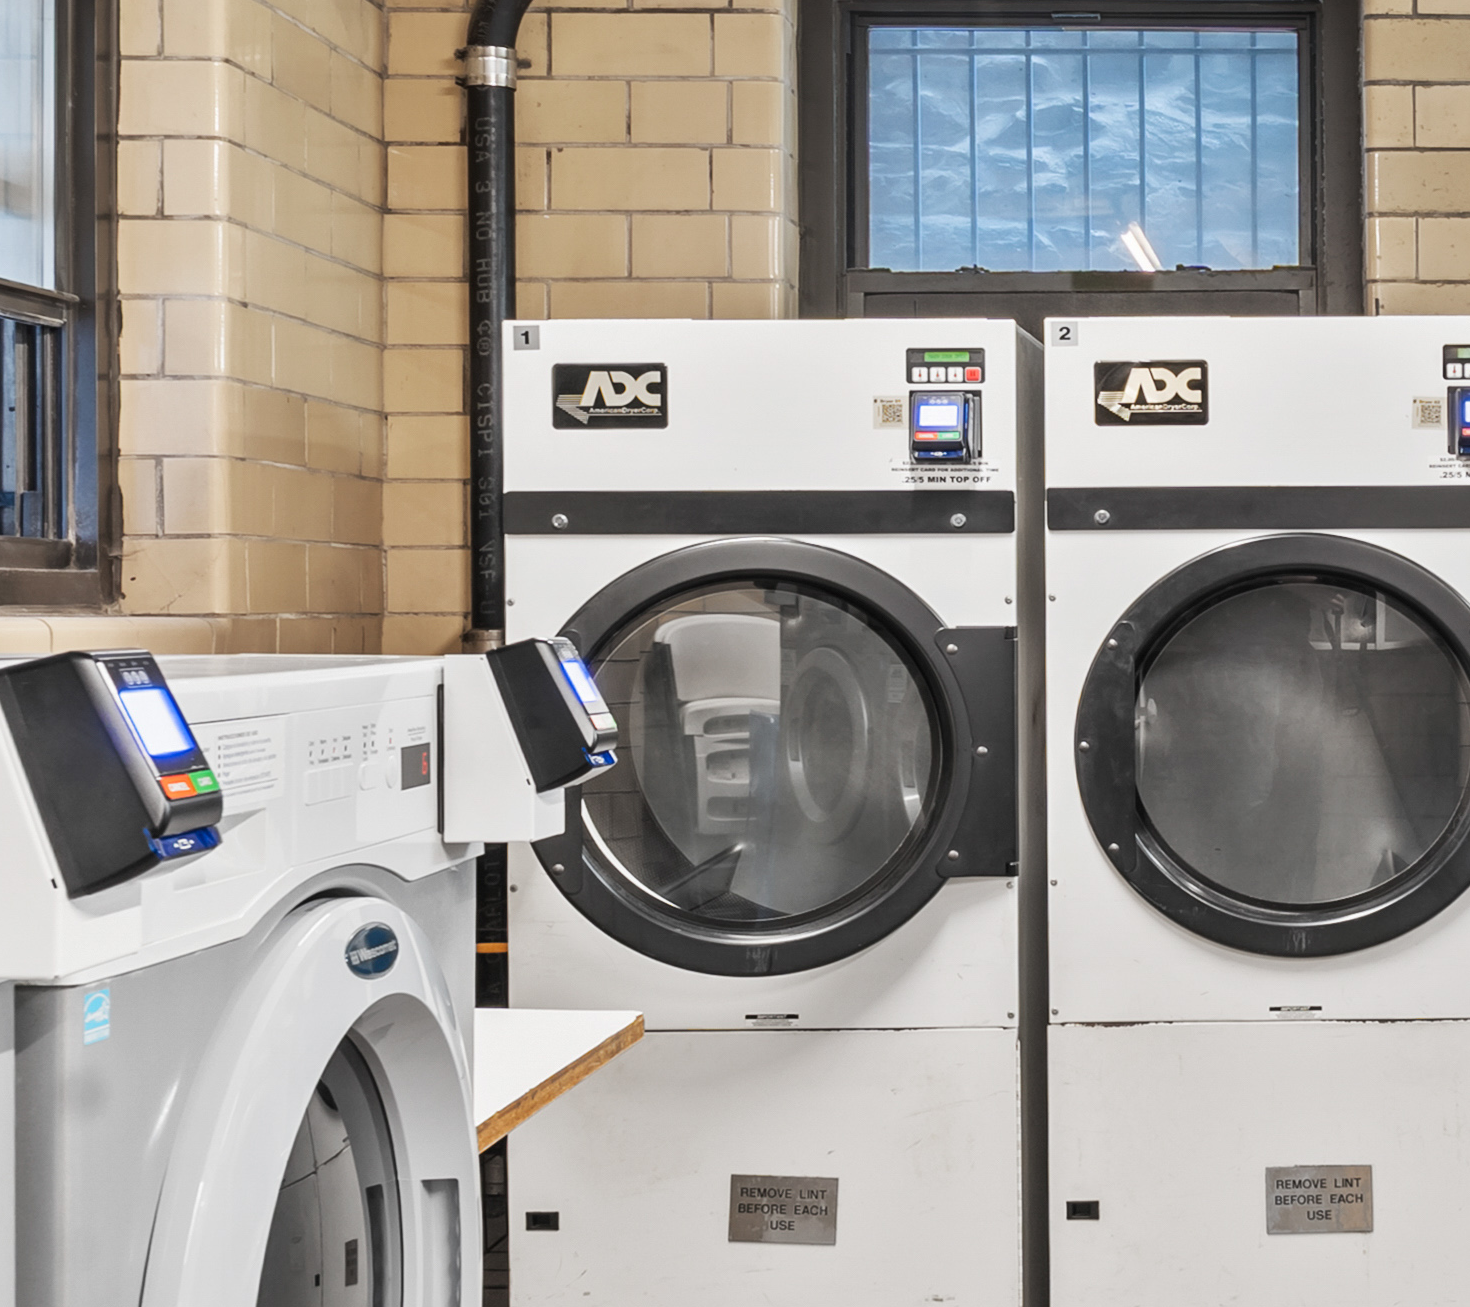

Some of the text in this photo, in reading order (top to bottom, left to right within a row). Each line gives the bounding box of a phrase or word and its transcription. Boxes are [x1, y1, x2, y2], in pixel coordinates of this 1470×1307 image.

[473, 116, 492, 164] USA
[474, 180, 491, 194] 3
[474, 211, 492, 241] NO
[474, 258, 492, 303] HUB
[520, 330, 530, 345] 1
[1058, 326, 1071, 341] 2
[579, 370, 661, 407] ADC
[1120, 367, 1203, 404] ADC
[1276, 1177, 1362, 1190] REMOVE LINT
[740, 1187, 828, 1200] REMOVE LINT
[1274, 1193, 1364, 1206] BEFORE EACH
[738, 1203, 829, 1216] BEFORE EACH
[1306, 1209, 1333, 1221] USE
[769, 1220, 796, 1231] USE
